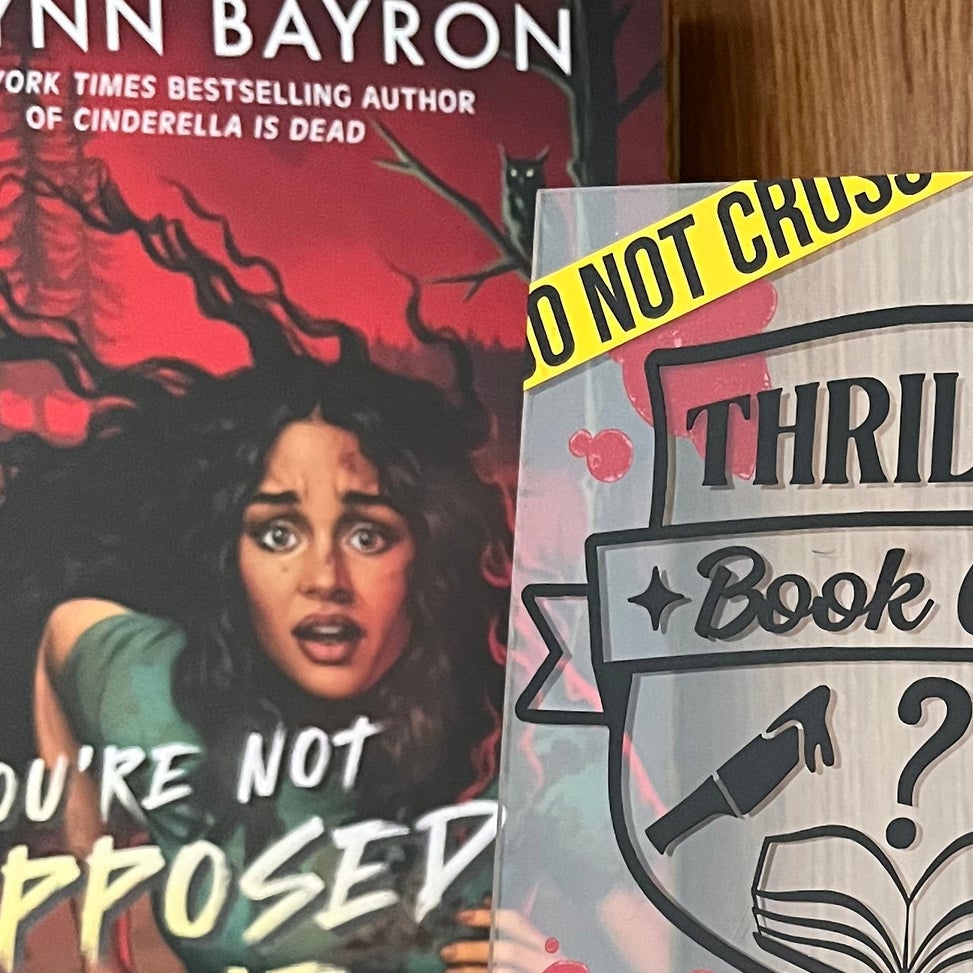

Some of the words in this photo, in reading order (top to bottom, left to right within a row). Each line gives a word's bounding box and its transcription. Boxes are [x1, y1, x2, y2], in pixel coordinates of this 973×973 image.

[213, 0, 572, 76] BAYRON
[26, 105, 62, 131] OF
[73, 108, 242, 139] CINDERELLA
[254, 115, 279, 141] IS
[289, 118, 366, 145] DEAD
[74, 71, 156, 99] TIMES
[168, 76, 352, 110] BESTSELLING
[361, 85, 476, 115] AUTHOR
[578, 213, 705, 343] NOT
[717, 172, 932, 275] CRO
[694, 545, 934, 641] Book
[237, 716, 383, 803] NOT
[0, 800, 508, 973] PPOSED
